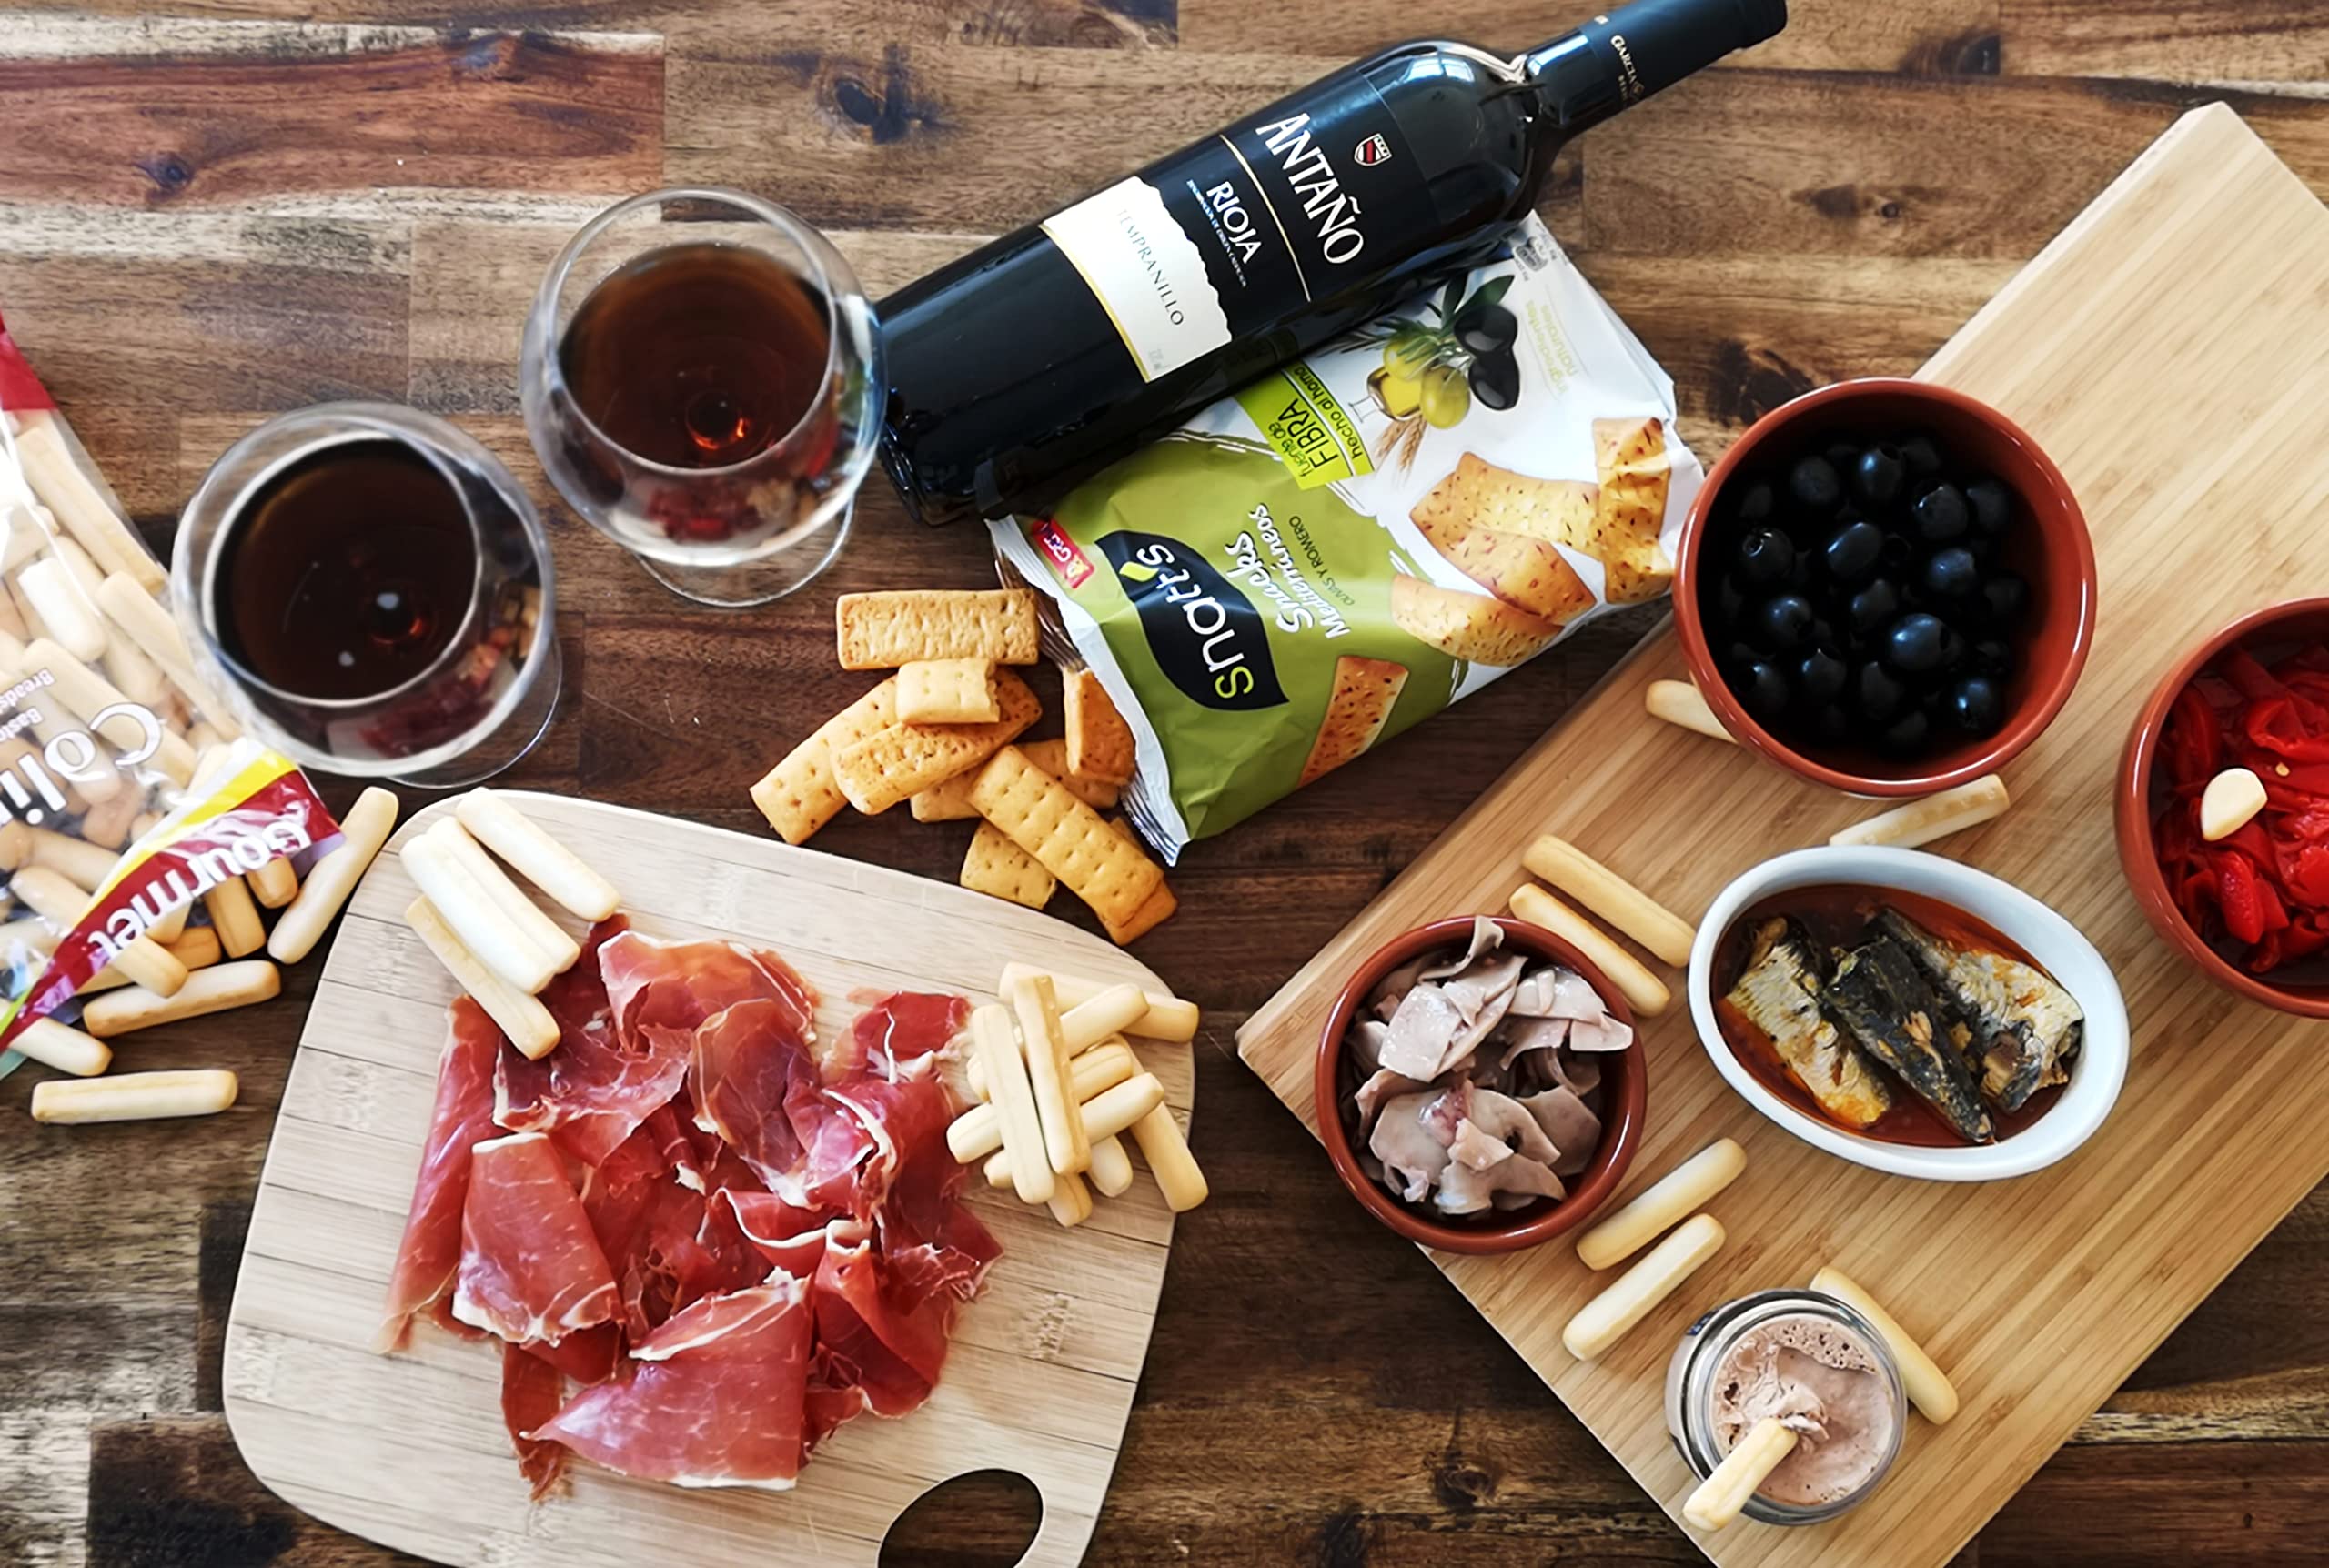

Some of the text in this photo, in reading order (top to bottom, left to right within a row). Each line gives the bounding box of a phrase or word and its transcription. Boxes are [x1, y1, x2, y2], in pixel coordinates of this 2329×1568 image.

[1205, 181, 1262, 265] RIOJA
[1255, 112, 1365, 264] ANTAÑO
[1116, 209, 1184, 325] TEMPRANILLO
[1268, 422, 1314, 477] fuente de
[1278, 398, 1339, 468] FIBRA
[1294, 366, 1364, 459] hecho al horno
[1224, 531, 1315, 633] Snacks
[1248, 503, 1351, 638] Mediterráneos
[1289, 516, 1324, 568] ROMERO
[1316, 568, 1328, 578] Y
[87, 819, 313, 960] Gourmet
